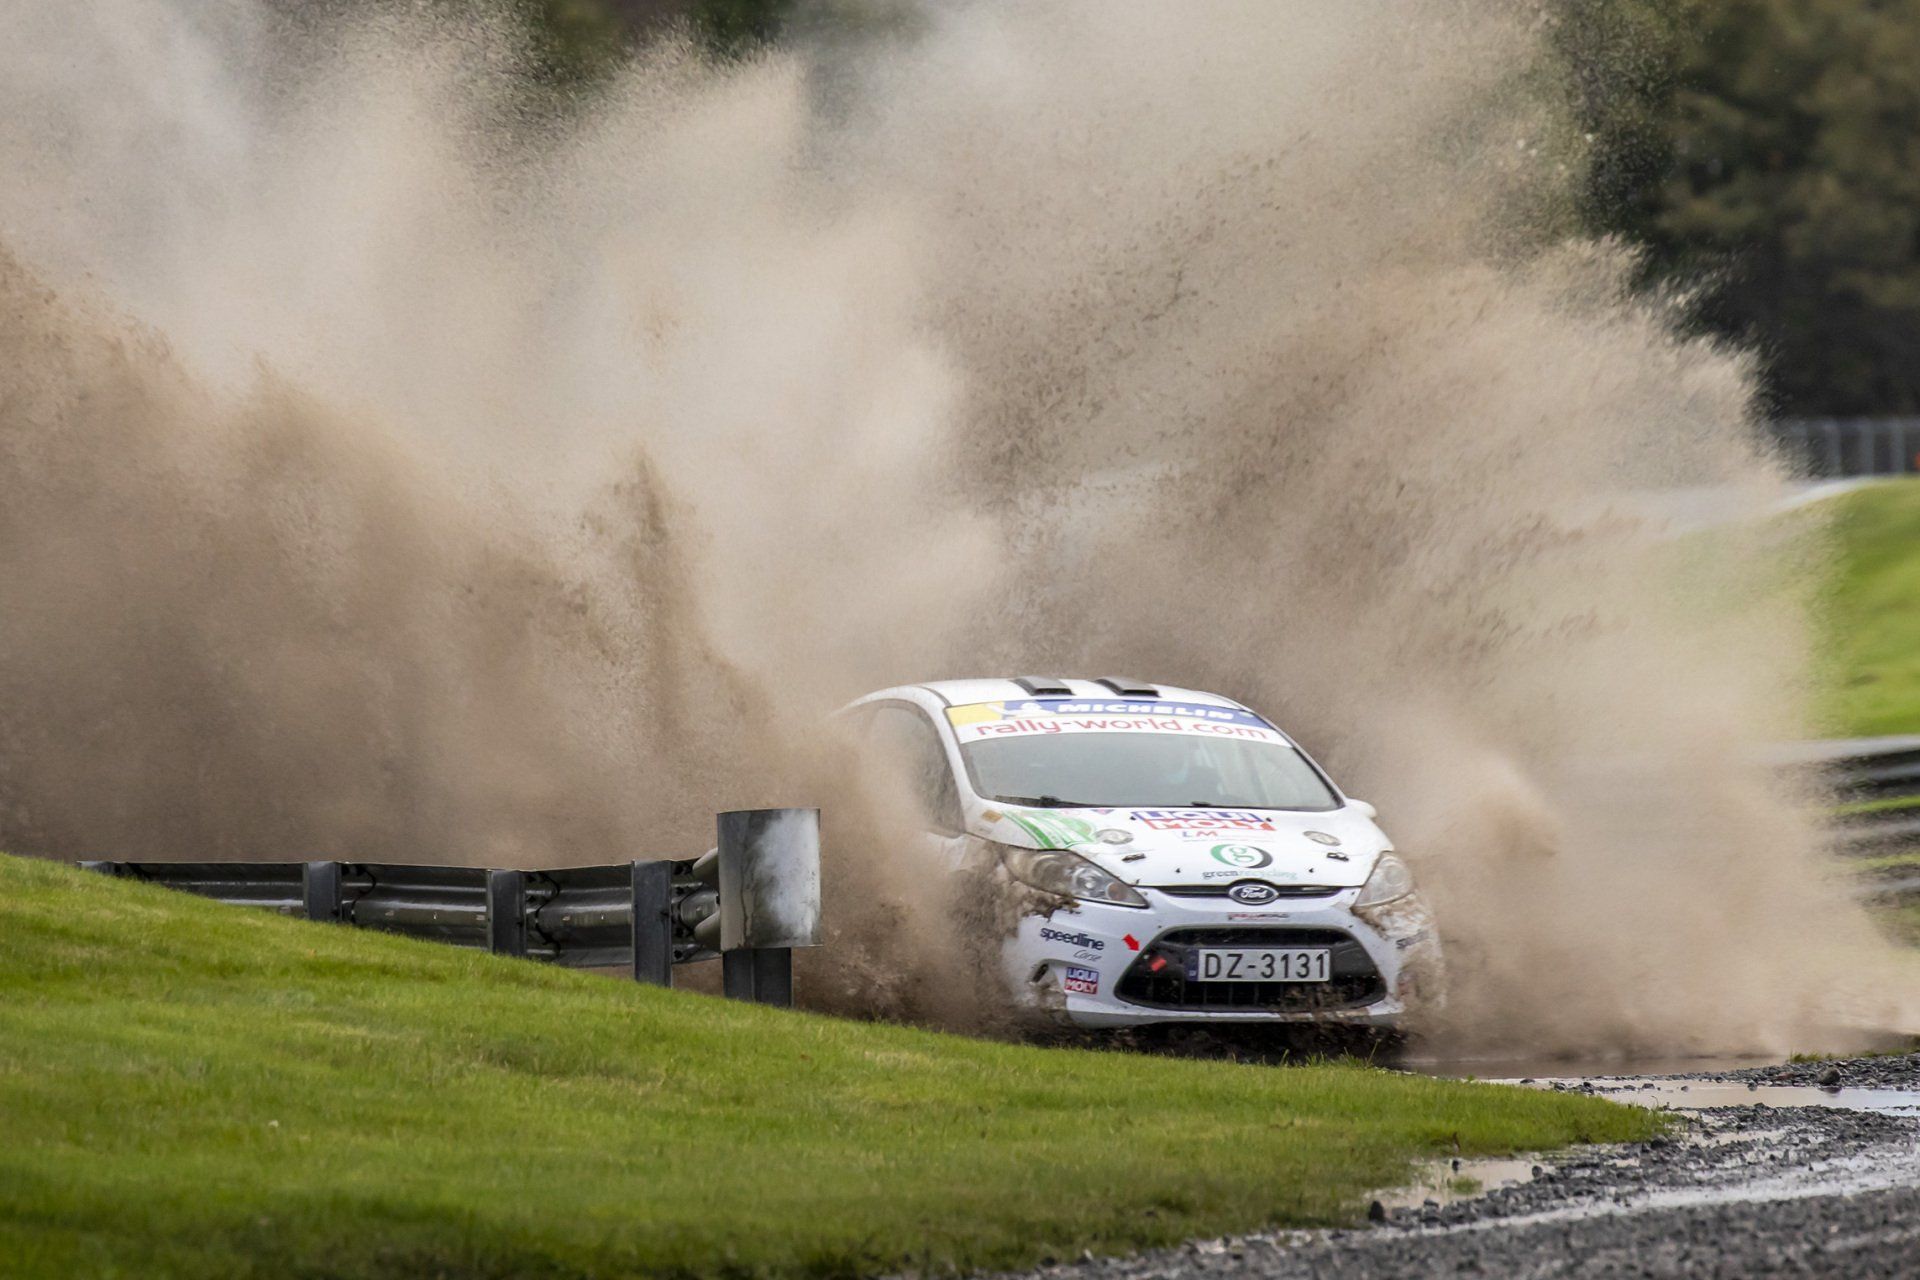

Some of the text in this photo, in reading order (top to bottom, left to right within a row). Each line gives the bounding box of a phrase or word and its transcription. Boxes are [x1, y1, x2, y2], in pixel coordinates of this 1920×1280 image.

[1058, 704, 1234, 720] MICHELIN
[976, 719, 1268, 739] rally-world.com
[1135, 811, 1264, 822] LIQUI
[1146, 819, 1270, 831] MOLY
[1240, 888, 1268, 899] Ford
[1040, 927, 1104, 950] speedline
[1073, 949, 1102, 962] Corse
[1204, 953, 1325, 979] DZ-3131
[1066, 967, 1099, 983] LIQUI
[1064, 979, 1098, 995] MOLY
